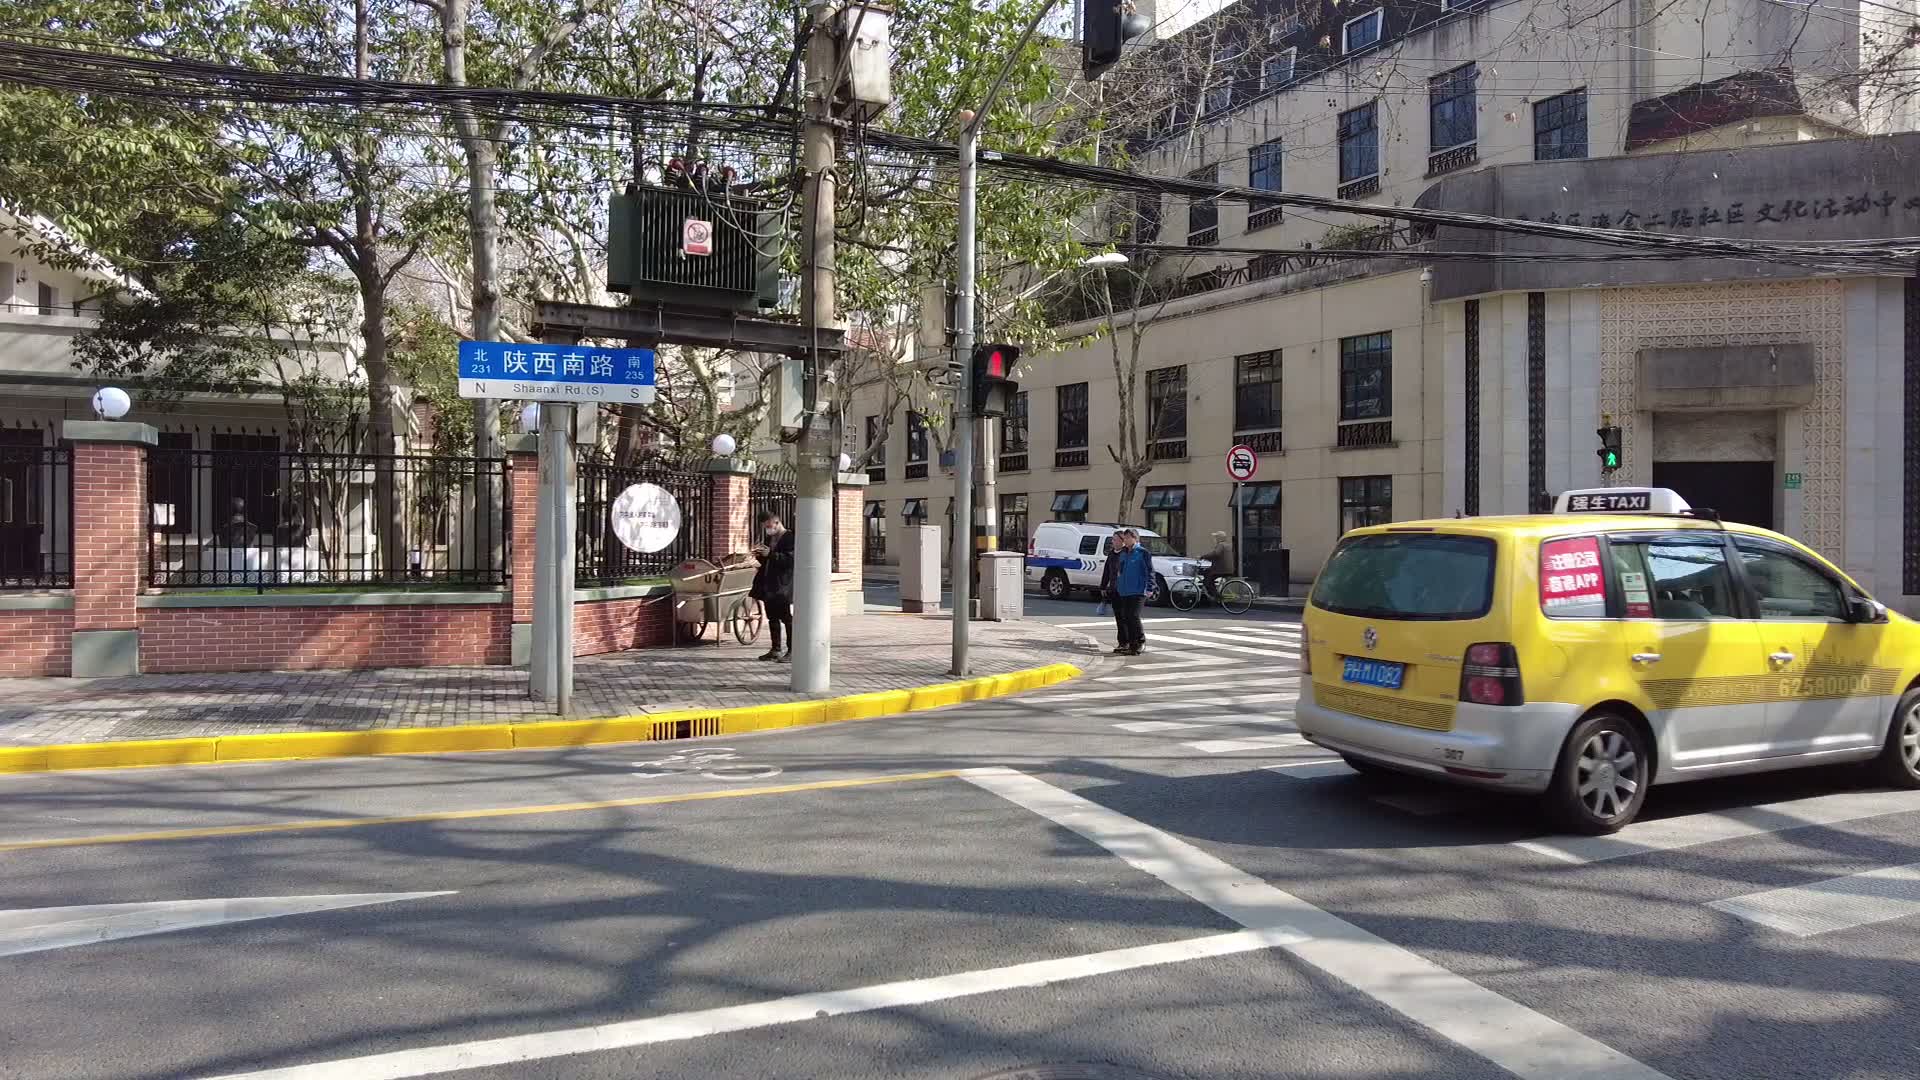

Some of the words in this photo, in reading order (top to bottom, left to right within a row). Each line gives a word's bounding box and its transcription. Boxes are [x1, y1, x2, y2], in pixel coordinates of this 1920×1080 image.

[474, 349, 488, 362] 北
[503, 350, 614, 377] 陕西南路
[628, 356, 641, 369] 南
[471, 364, 491, 374] 231
[625, 371, 644, 380] 235
[475, 383, 486, 393] N
[513, 383, 560, 394] Shaanxi
[630, 388, 640, 399] S
